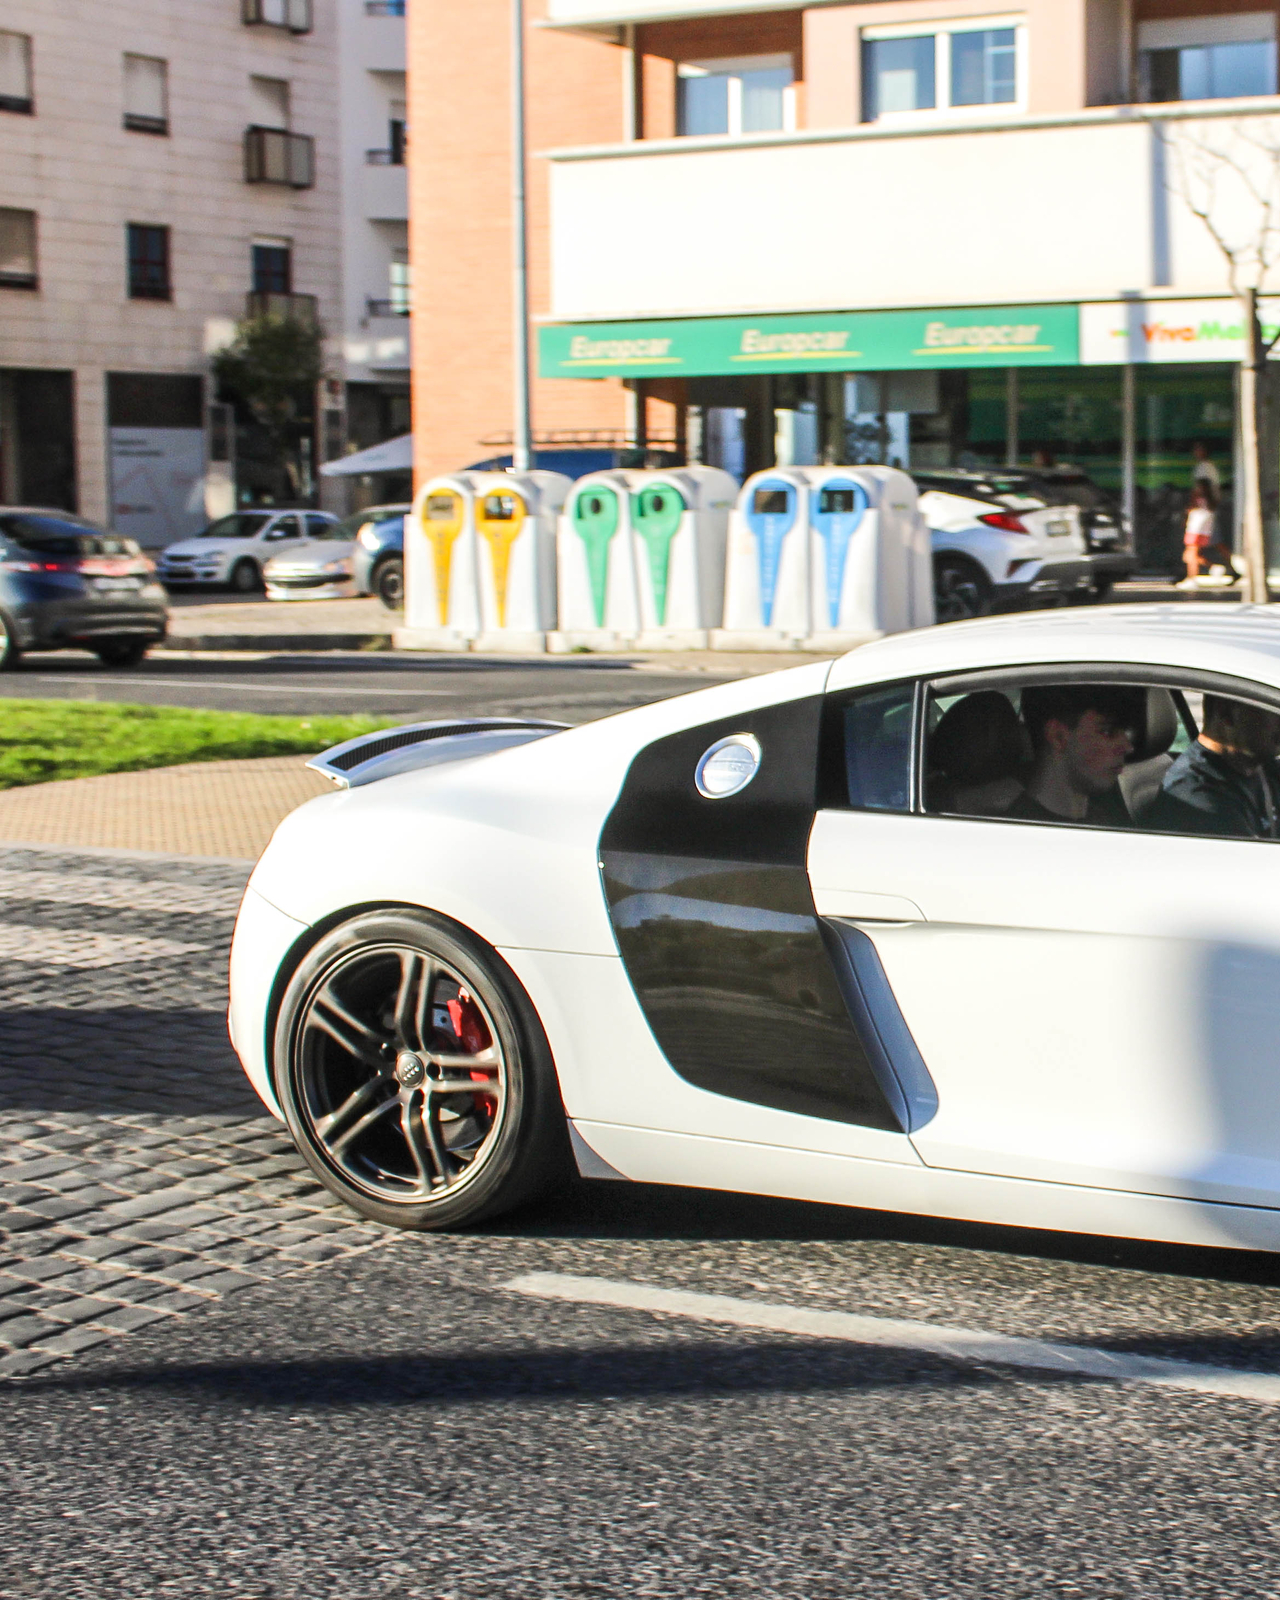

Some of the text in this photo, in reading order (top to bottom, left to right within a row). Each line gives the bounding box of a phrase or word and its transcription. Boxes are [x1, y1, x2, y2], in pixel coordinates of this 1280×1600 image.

[570, 335, 673, 364] Europcar
[741, 328, 850, 358] Europcar
[924, 322, 1042, 353] Europcar
